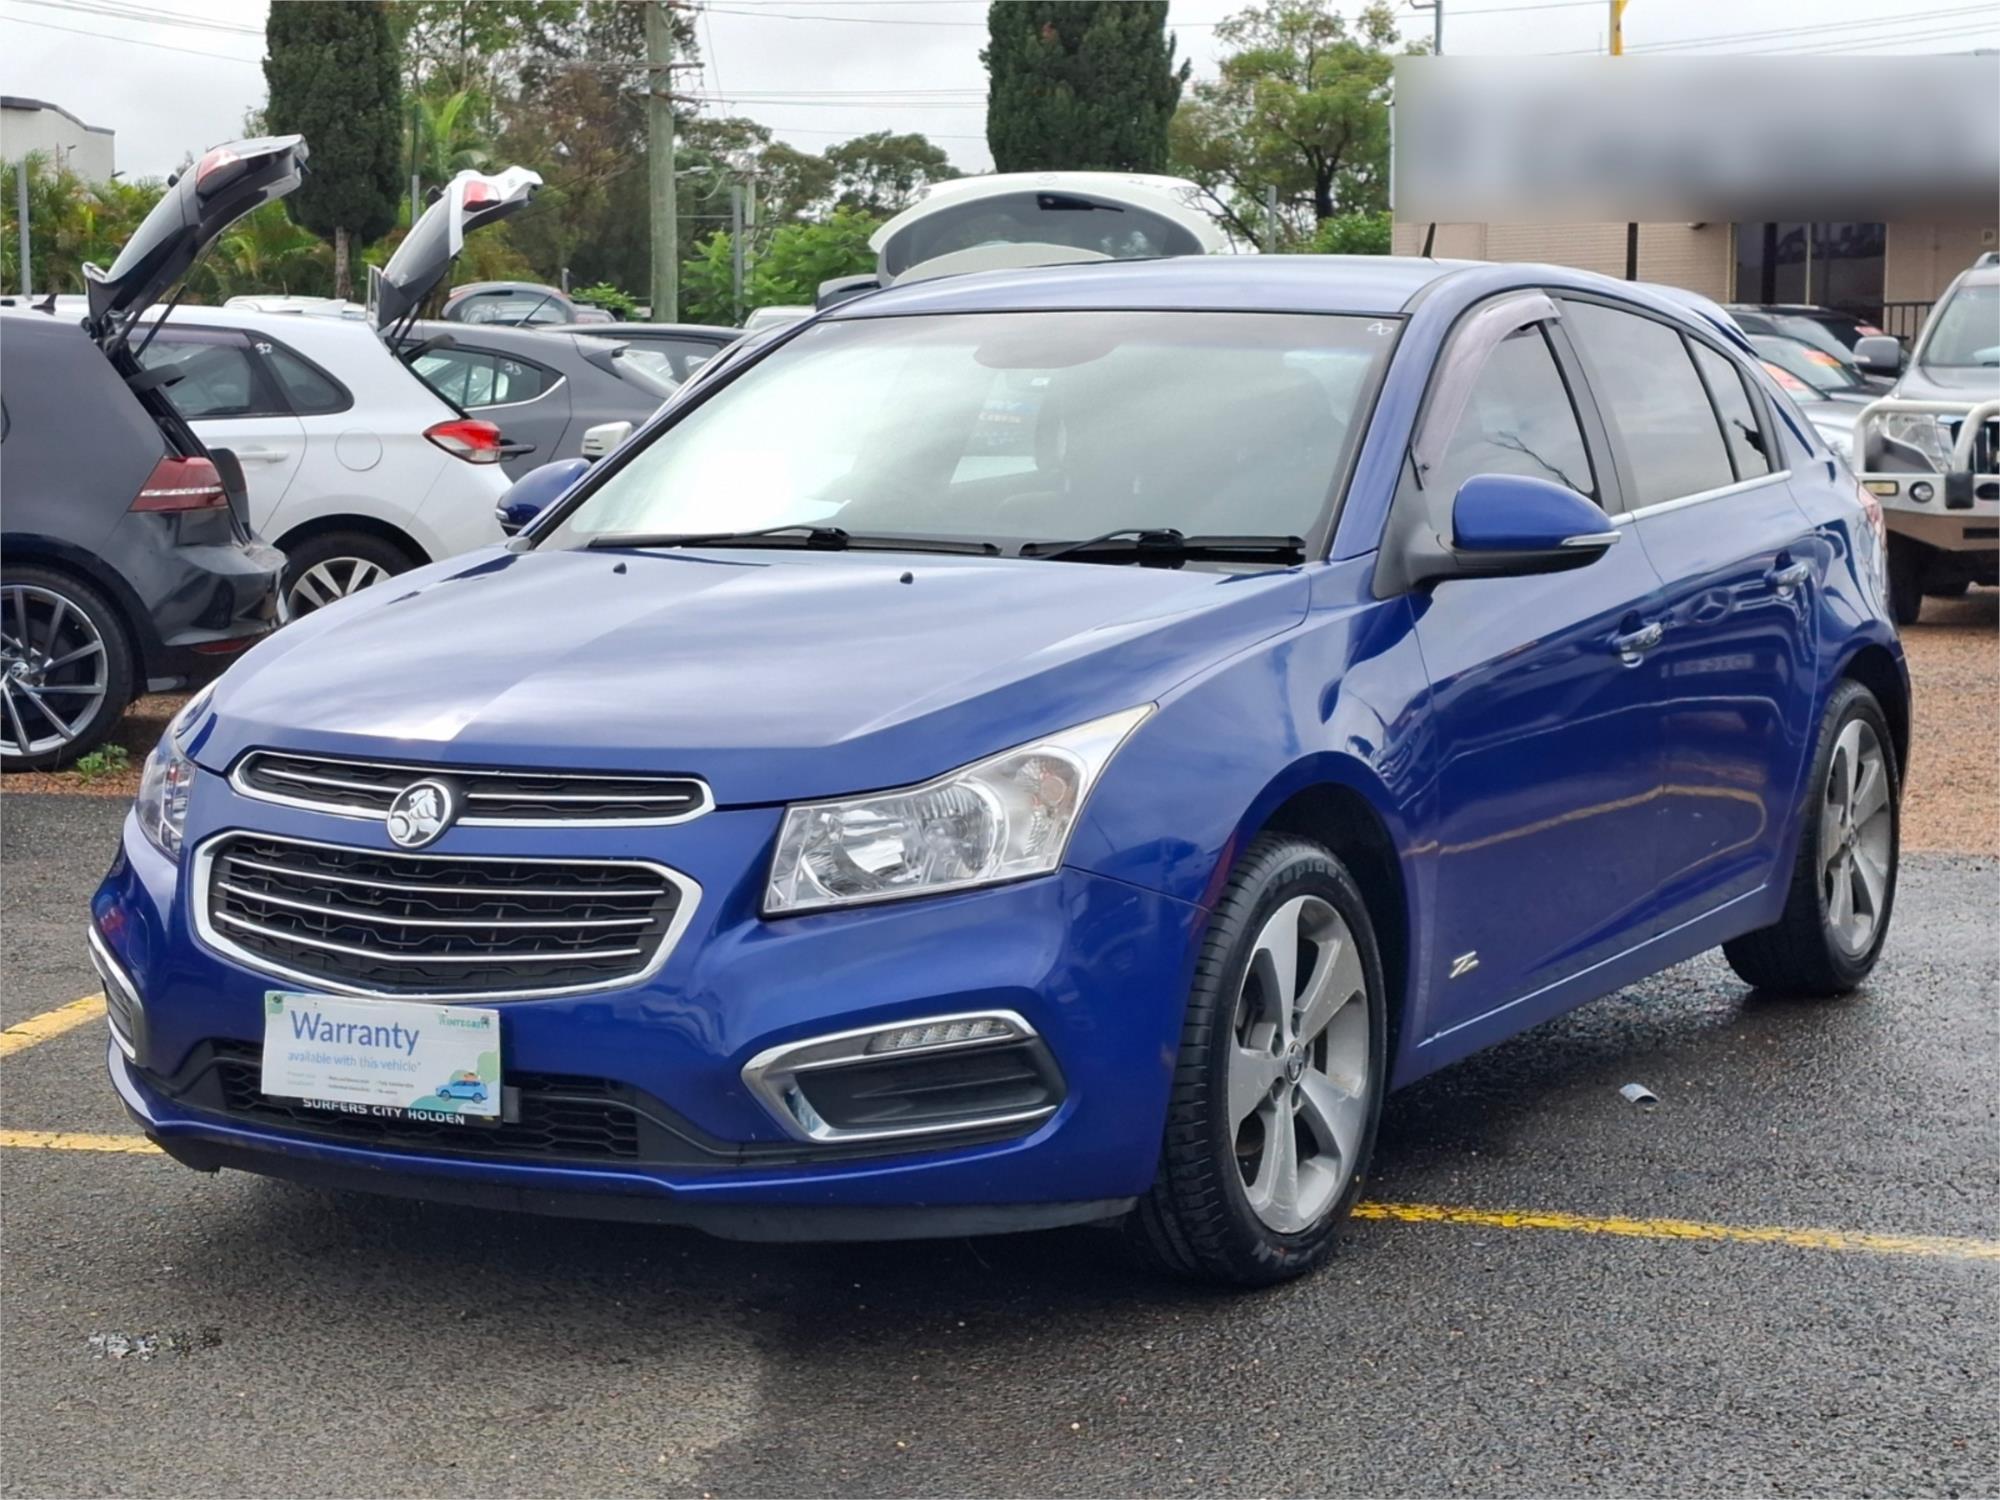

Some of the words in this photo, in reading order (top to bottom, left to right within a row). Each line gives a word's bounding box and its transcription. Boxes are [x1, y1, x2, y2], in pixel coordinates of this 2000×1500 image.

[291, 1010, 419, 1056] Warranty
[288, 1052, 332, 1065] available
[334, 1056, 357, 1067] with
[360, 1056, 379, 1069] this
[303, 1098, 368, 1115] SURFERS
[372, 1105, 402, 1118] CITY
[408, 1110, 465, 1125] HOLDEN
